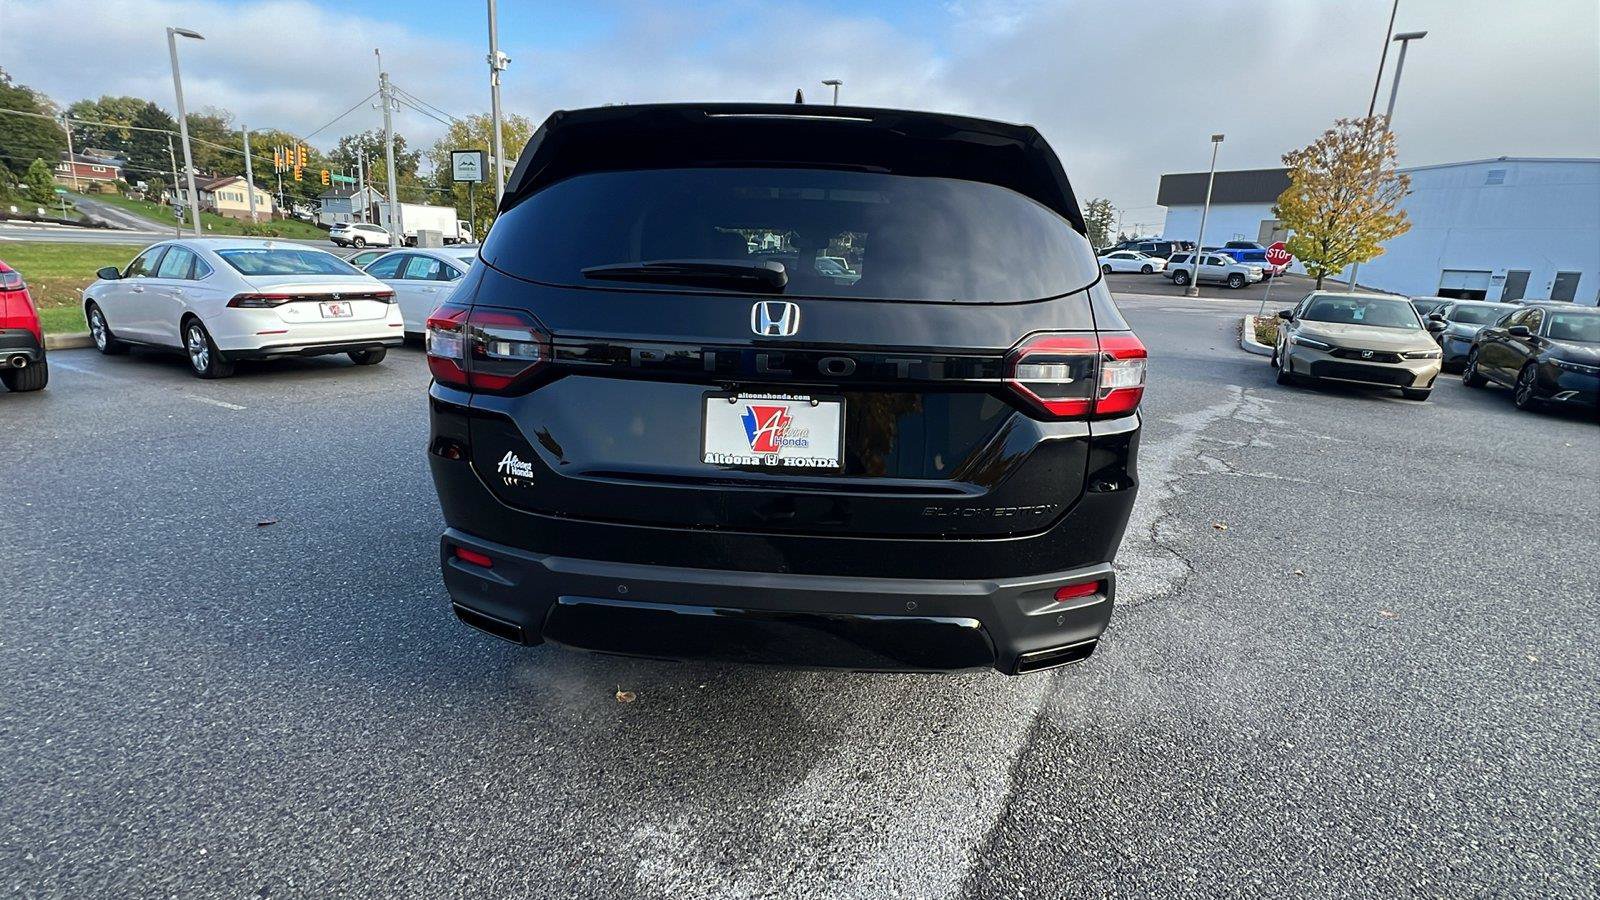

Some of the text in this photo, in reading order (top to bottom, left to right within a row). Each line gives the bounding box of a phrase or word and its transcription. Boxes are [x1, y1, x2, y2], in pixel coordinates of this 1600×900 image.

[1268, 249, 1291, 260] STOP
[630, 348, 922, 378] PILOT
[738, 392, 811, 401] altoonahonda.com
[774, 436, 808, 447] Honda
[704, 453, 760, 465] Altoona
[783, 456, 839, 468] HONDA
[922, 503, 1059, 517] BLACK EDITION
